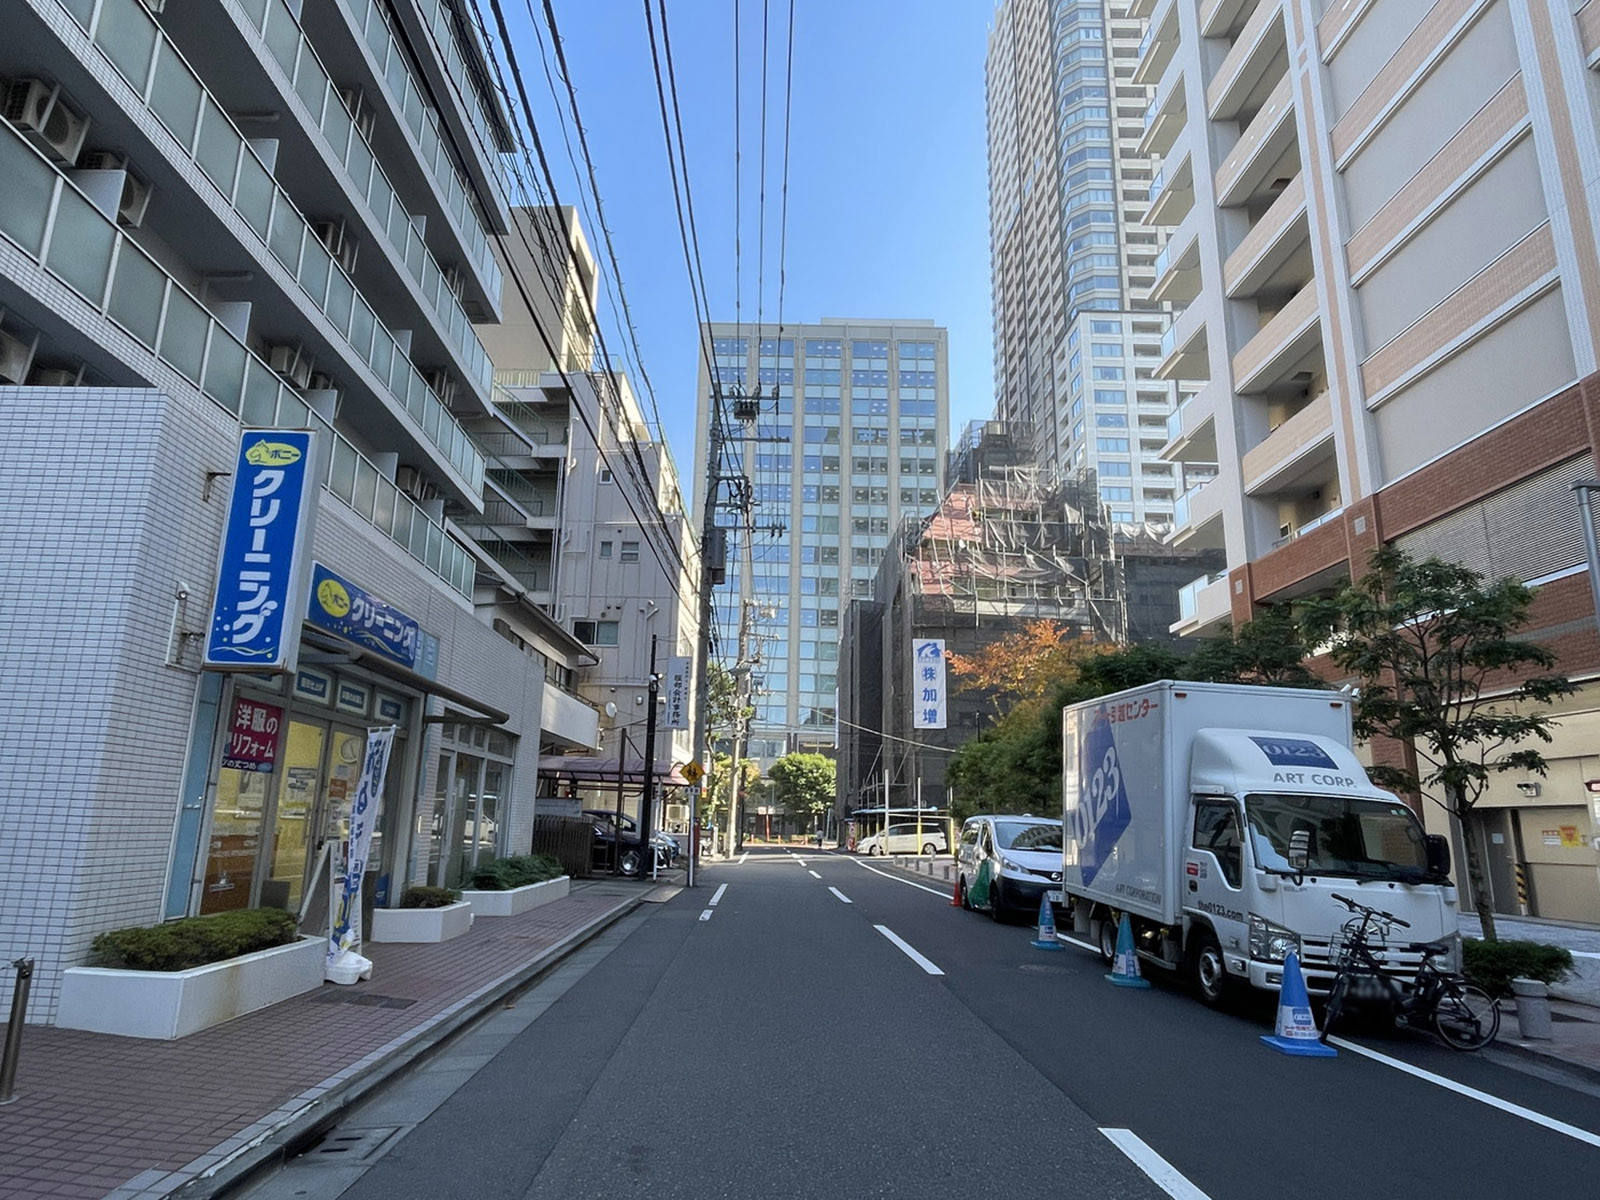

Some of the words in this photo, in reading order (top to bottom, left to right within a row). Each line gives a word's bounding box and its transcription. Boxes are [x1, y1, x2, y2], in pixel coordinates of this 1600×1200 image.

[232, 469, 285, 644] クリーニング
[351, 597, 417, 648] クリーニング
[236, 703, 278, 735] 洋服の
[232, 733, 274, 758] リフォーム
[1262, 743, 1326, 759] 0123
[1273, 772, 1305, 785] ART
[1311, 774, 1358, 788] CORP.
[1074, 746, 1120, 850] 0123
[1197, 899, 1243, 922] the0123.com
